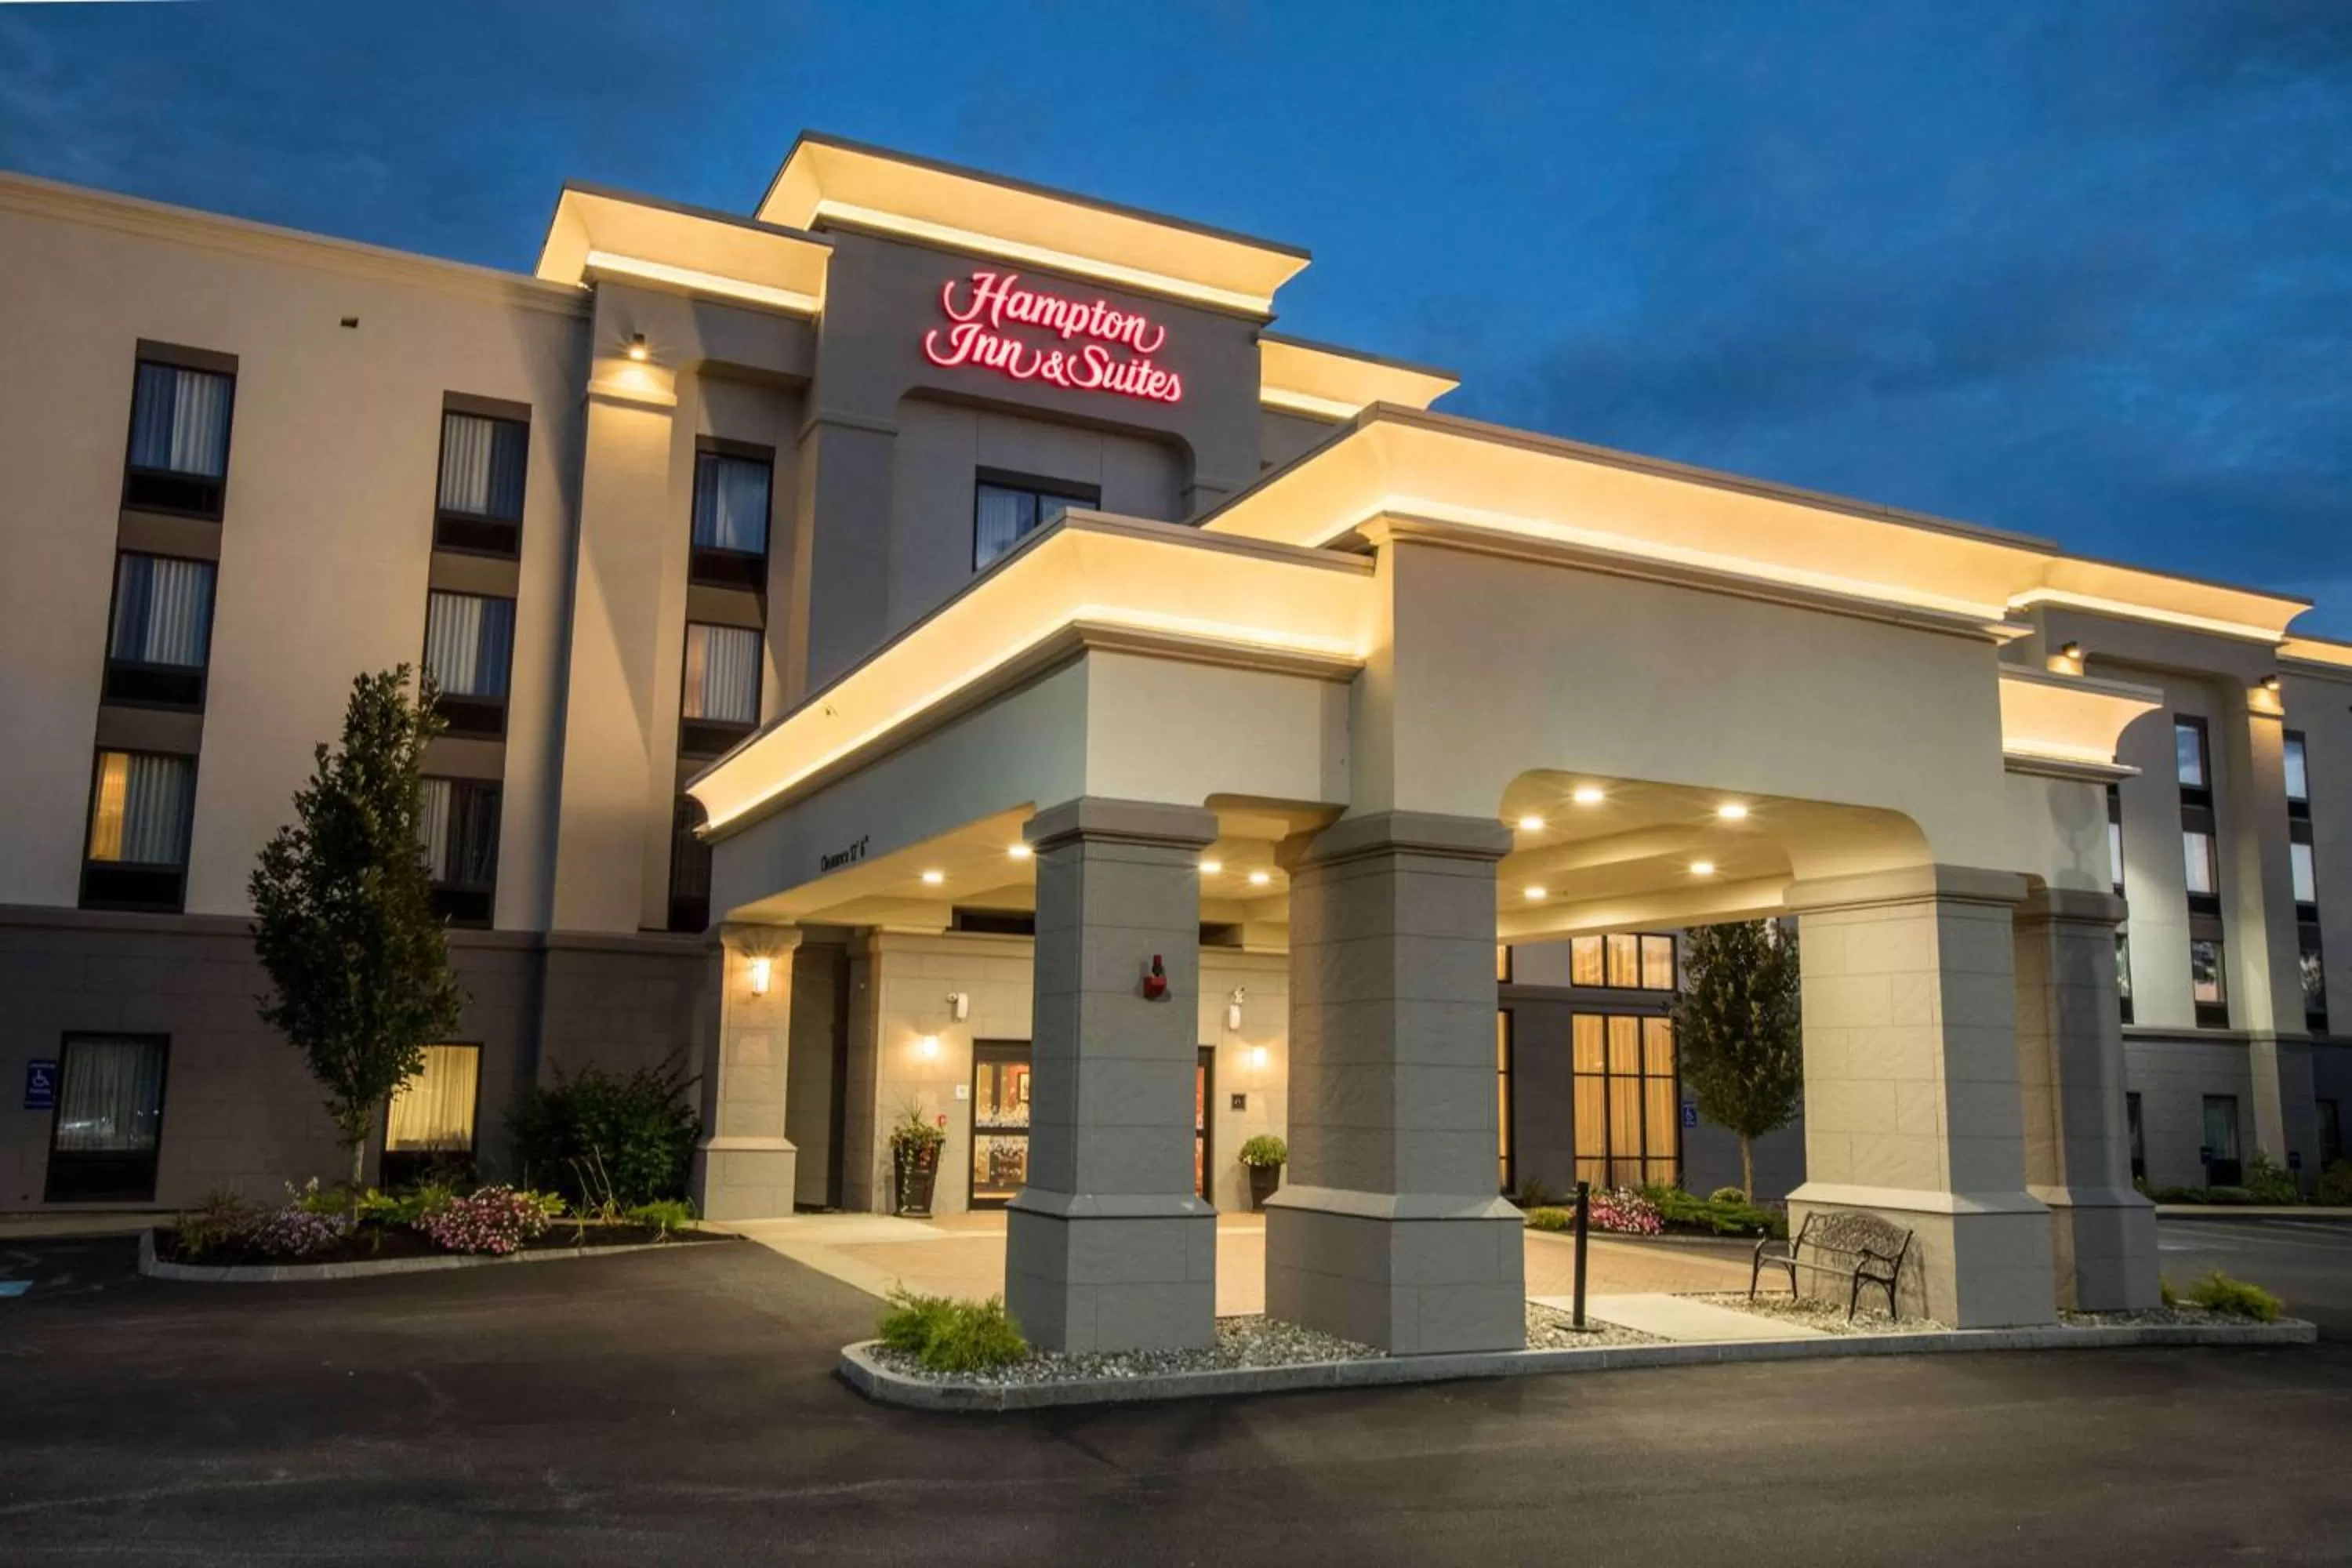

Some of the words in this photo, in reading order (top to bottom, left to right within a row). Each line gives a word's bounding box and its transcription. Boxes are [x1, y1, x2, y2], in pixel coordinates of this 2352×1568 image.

[943, 272, 1165, 353] Hampton
[925, 322, 1042, 379] Inn
[1040, 350, 1071, 387] &
[1066, 343, 1182, 402] Suites
